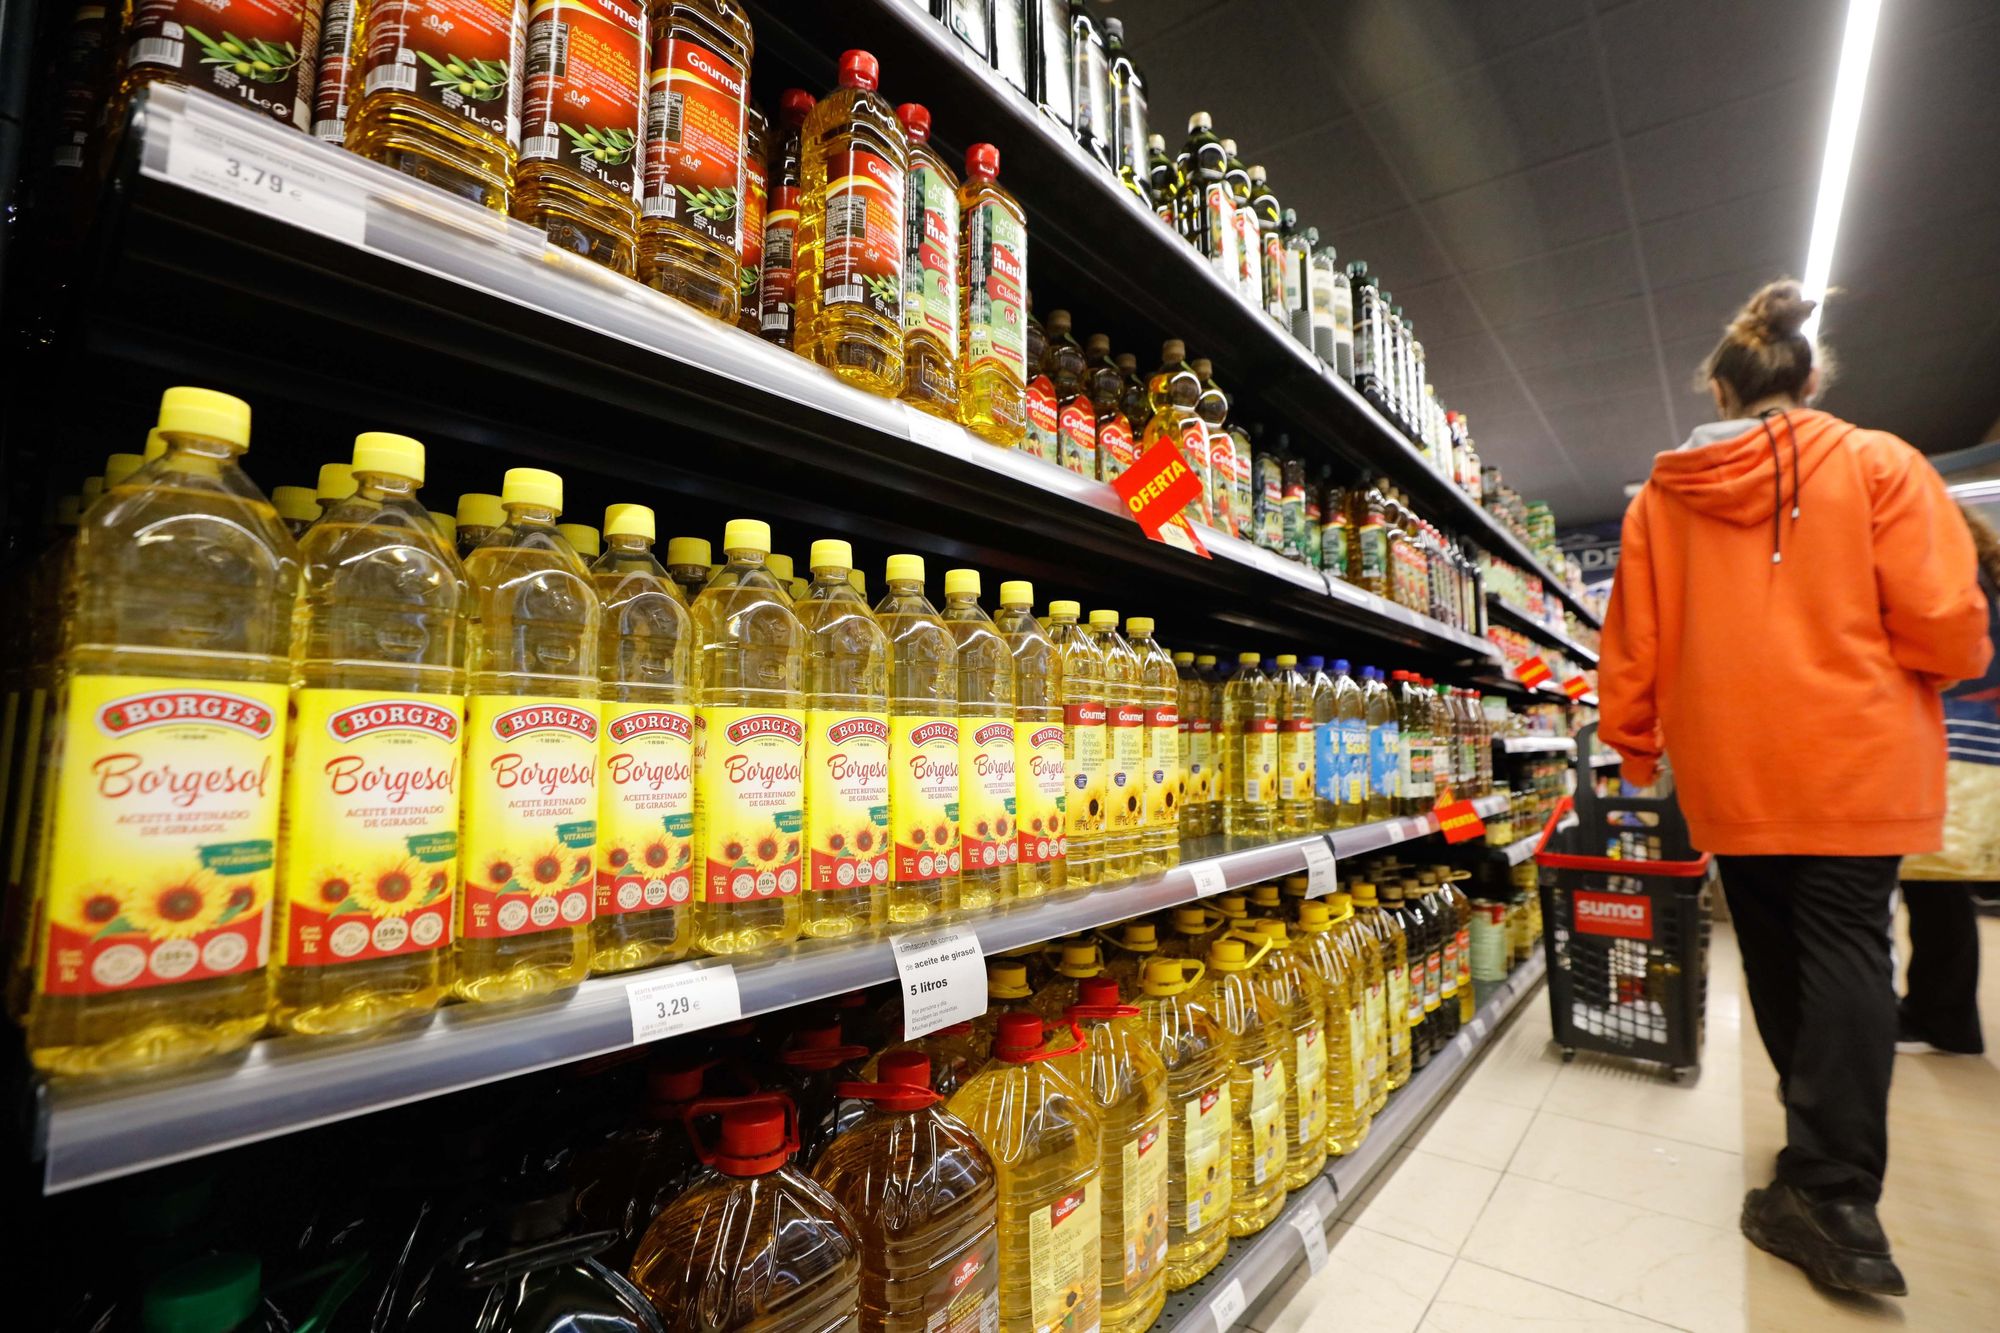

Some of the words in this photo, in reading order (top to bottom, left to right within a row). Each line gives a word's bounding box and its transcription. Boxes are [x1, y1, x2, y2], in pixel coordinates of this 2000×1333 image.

[571, 25, 599, 46] Aceite
[601, 43, 612, 54] de
[613, 51, 631, 67] oliva
[686, 96, 708, 112] Aceite
[226, 157, 284, 194] 3.79
[926, 213, 935, 226] la
[1000, 217, 1018, 234] ACEI
[1007, 231, 1019, 244] OLI
[930, 252, 948, 270] Clás
[993, 247, 1001, 259] la
[1026, 395, 1057, 420] Carbon
[1063, 415, 1095, 437] Carbon
[1128, 460, 1186, 513] OFERTA
[123, 697, 258, 727] BORGES
[350, 706, 450, 731] BORGES
[510, 710, 591, 732] BORGES
[1079, 708, 1106, 720] Gourmet
[1119, 710, 1144, 722] Gourmet
[1156, 711, 1178, 722] Gourmet
[623, 715, 688, 733] BORGES
[740, 720, 796, 737] BORGES
[839, 723, 886, 738] BORGES
[983, 725, 1014, 740] BORGES
[920, 727, 958, 740] BORGES
[1037, 729, 1064, 742] BORGES
[490, 753, 597, 795] Borgesol
[607, 753, 693, 790] Borgesol
[725, 754, 802, 789] Borgesol
[827, 754, 887, 785] Borgeso
[910, 755, 958, 784] Borges
[974, 754, 1014, 780] Borges
[1029, 755, 1064, 780] Borges
[91, 753, 272, 807] Borgesol
[325, 756, 457, 803] Borgesol
[508, 799, 543, 809] ACEITE
[543, 797, 586, 807] REFINADO
[623, 794, 651, 802] ACEITE
[652, 792, 687, 800] REFINADO
[635, 802, 646, 810] DE
[647, 801, 677, 809] GIRASOL
[345, 808, 388, 818] ACEITE
[389, 805, 445, 816] REFINADO
[523, 809, 536, 817] DE
[536, 807, 573, 817] GIRASOL
[363, 819, 380, 829] DE
[380, 816, 428, 827] GIRASOL
[646, 887, 665, 896] 100%
[758, 879, 774, 887] 100%
[534, 905, 556, 915] 100%
[1577, 899, 1644, 919] suma
[938, 934, 959, 944] compra
[914, 957, 939, 969] aceite
[940, 954, 950, 962] de
[951, 946, 976, 961] girasol
[910, 984, 917, 996] 5
[920, 978, 948, 993] litros
[657, 996, 689, 1019] 3.29
[1056, 1198, 1080, 1217] Gourmet
[954, 1262, 979, 1287] Gourmet
